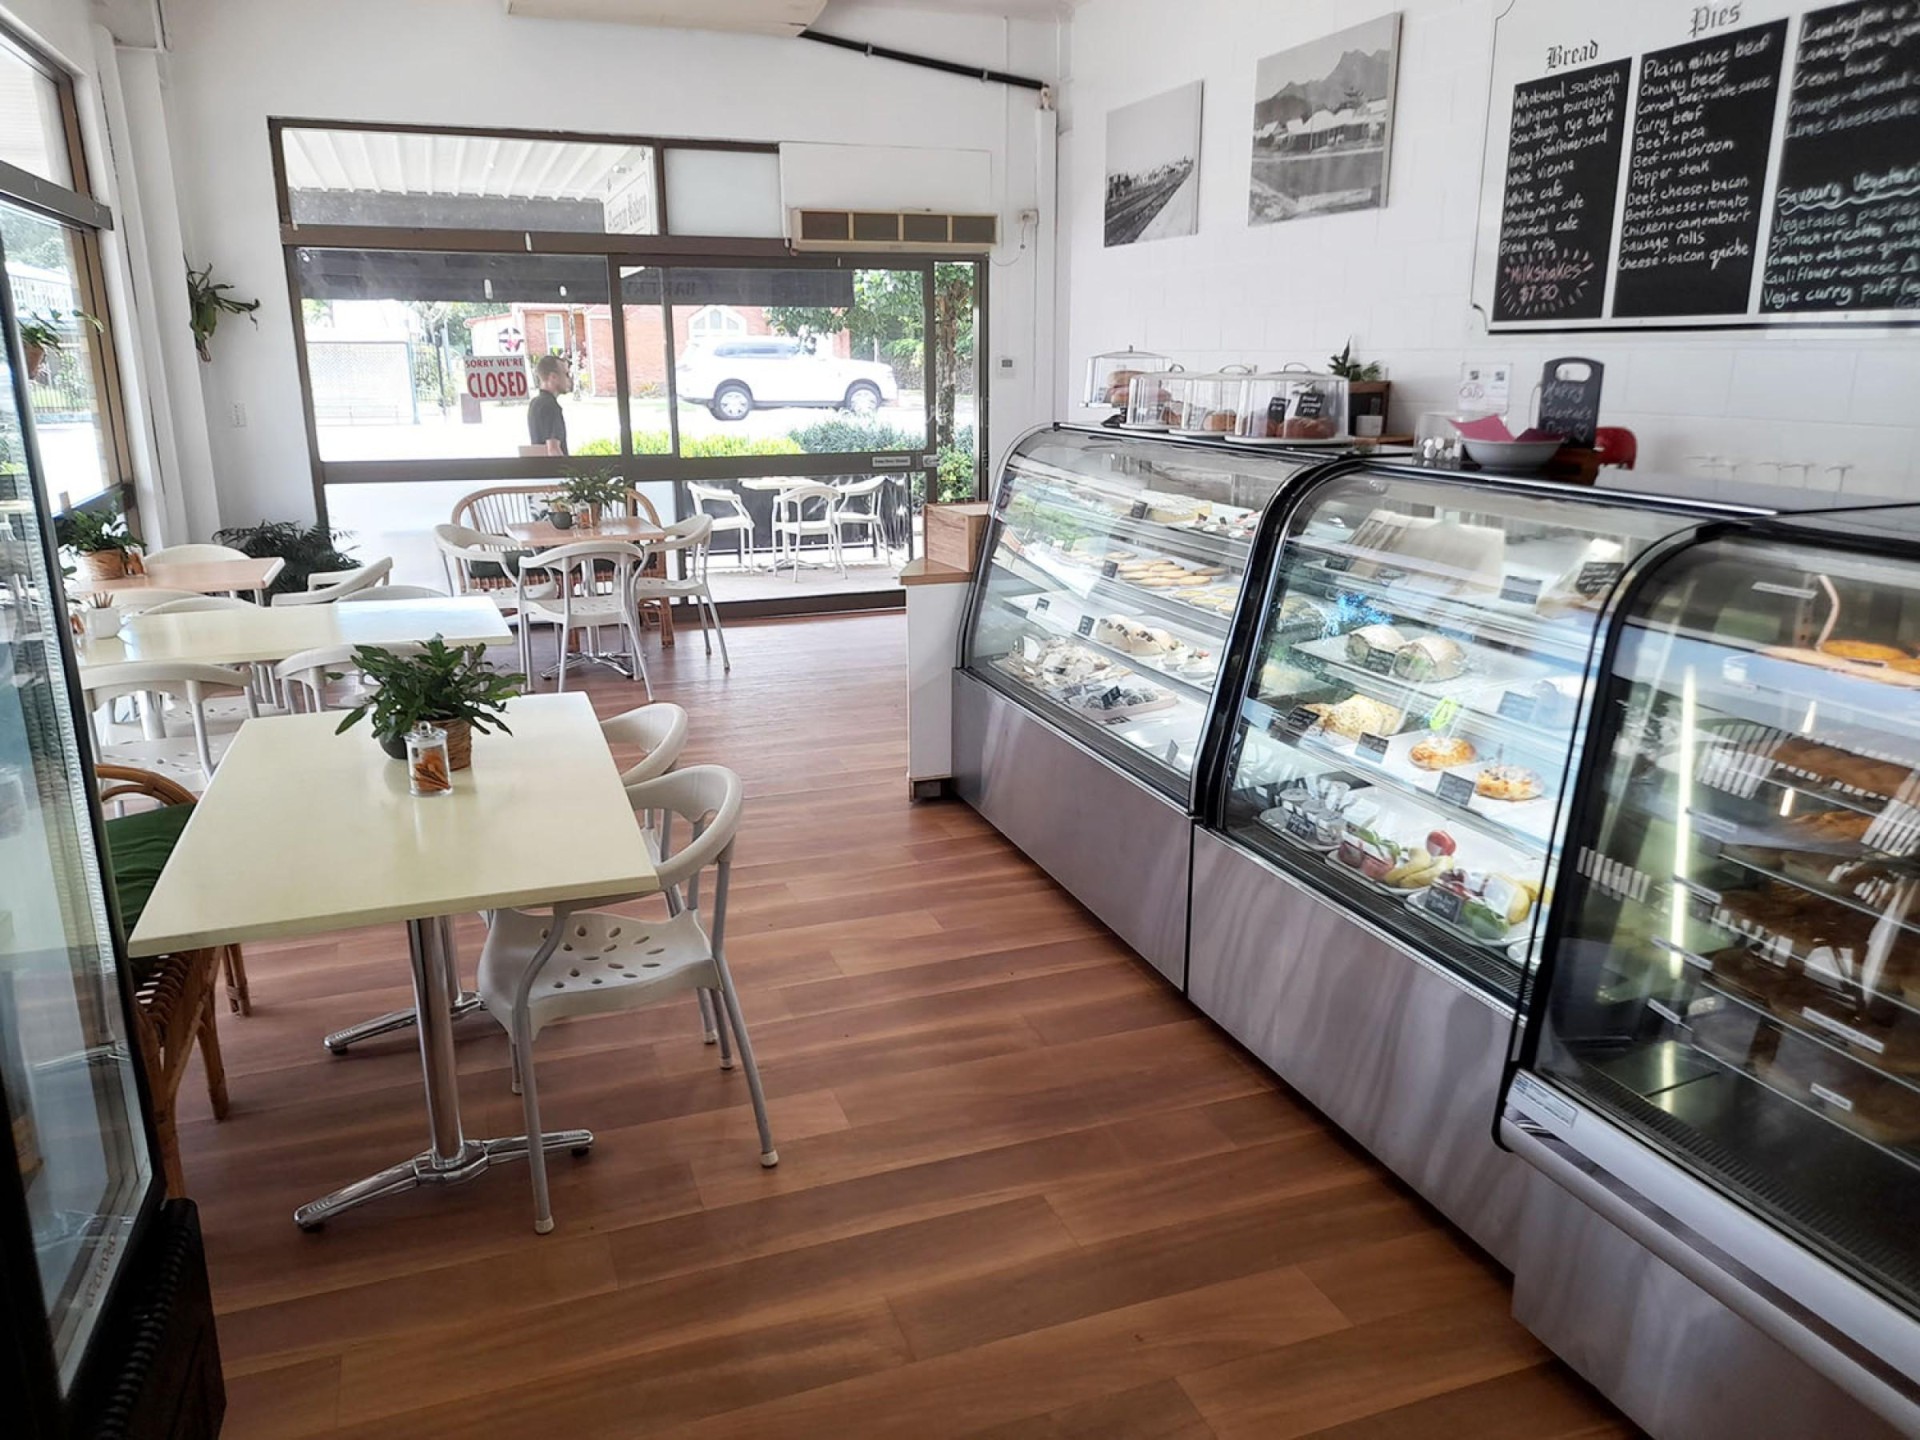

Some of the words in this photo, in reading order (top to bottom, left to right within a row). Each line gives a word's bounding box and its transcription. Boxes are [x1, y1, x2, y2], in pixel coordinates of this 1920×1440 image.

[1688, 2, 1742, 38] Pies
[1545, 39, 1599, 71] Bread
[1643, 59, 1684, 80] Plain
[1688, 50, 1730, 70] mince
[1734, 32, 1772, 58] beef
[1640, 79, 1686, 97] Chunky
[1690, 65, 1727, 88] beef
[1790, 70, 1840, 91] Cream
[1564, 117, 1583, 138] rye
[1586, 107, 1614, 128] dark
[1635, 118, 1668, 135] Curry
[1672, 103, 1705, 126] beef
[1632, 150, 1661, 168] Beef
[1669, 140, 1734, 161] mushroom
[1635, 130, 1671, 152] Beef
[1681, 126, 1706, 145] pea
[1631, 167, 1673, 189] Pepper
[1678, 159, 1711, 177] steak
[1660, 184, 1703, 199] cheese
[1711, 176, 1749, 193] bacon
[1655, 201, 1697, 216] cheese
[1706, 194, 1749, 211] tomato
[1622, 222, 1667, 238] Chicken
[1675, 208, 1752, 230] camembert
[1774, 213, 1850, 236] Vegetable
[1618, 255, 1660, 271] Cheese
[1668, 250, 1706, 265] bacon
[1708, 236, 1750, 271] quiche
[1620, 235, 1670, 254] Sausage
[1676, 230, 1706, 245] rolls
[1804, 285, 1853, 306] curry
[1861, 275, 1899, 303] puff
[465, 358, 494, 369] SORRY
[497, 357, 524, 368] WE'RE
[467, 370, 528, 399] CLOSED
